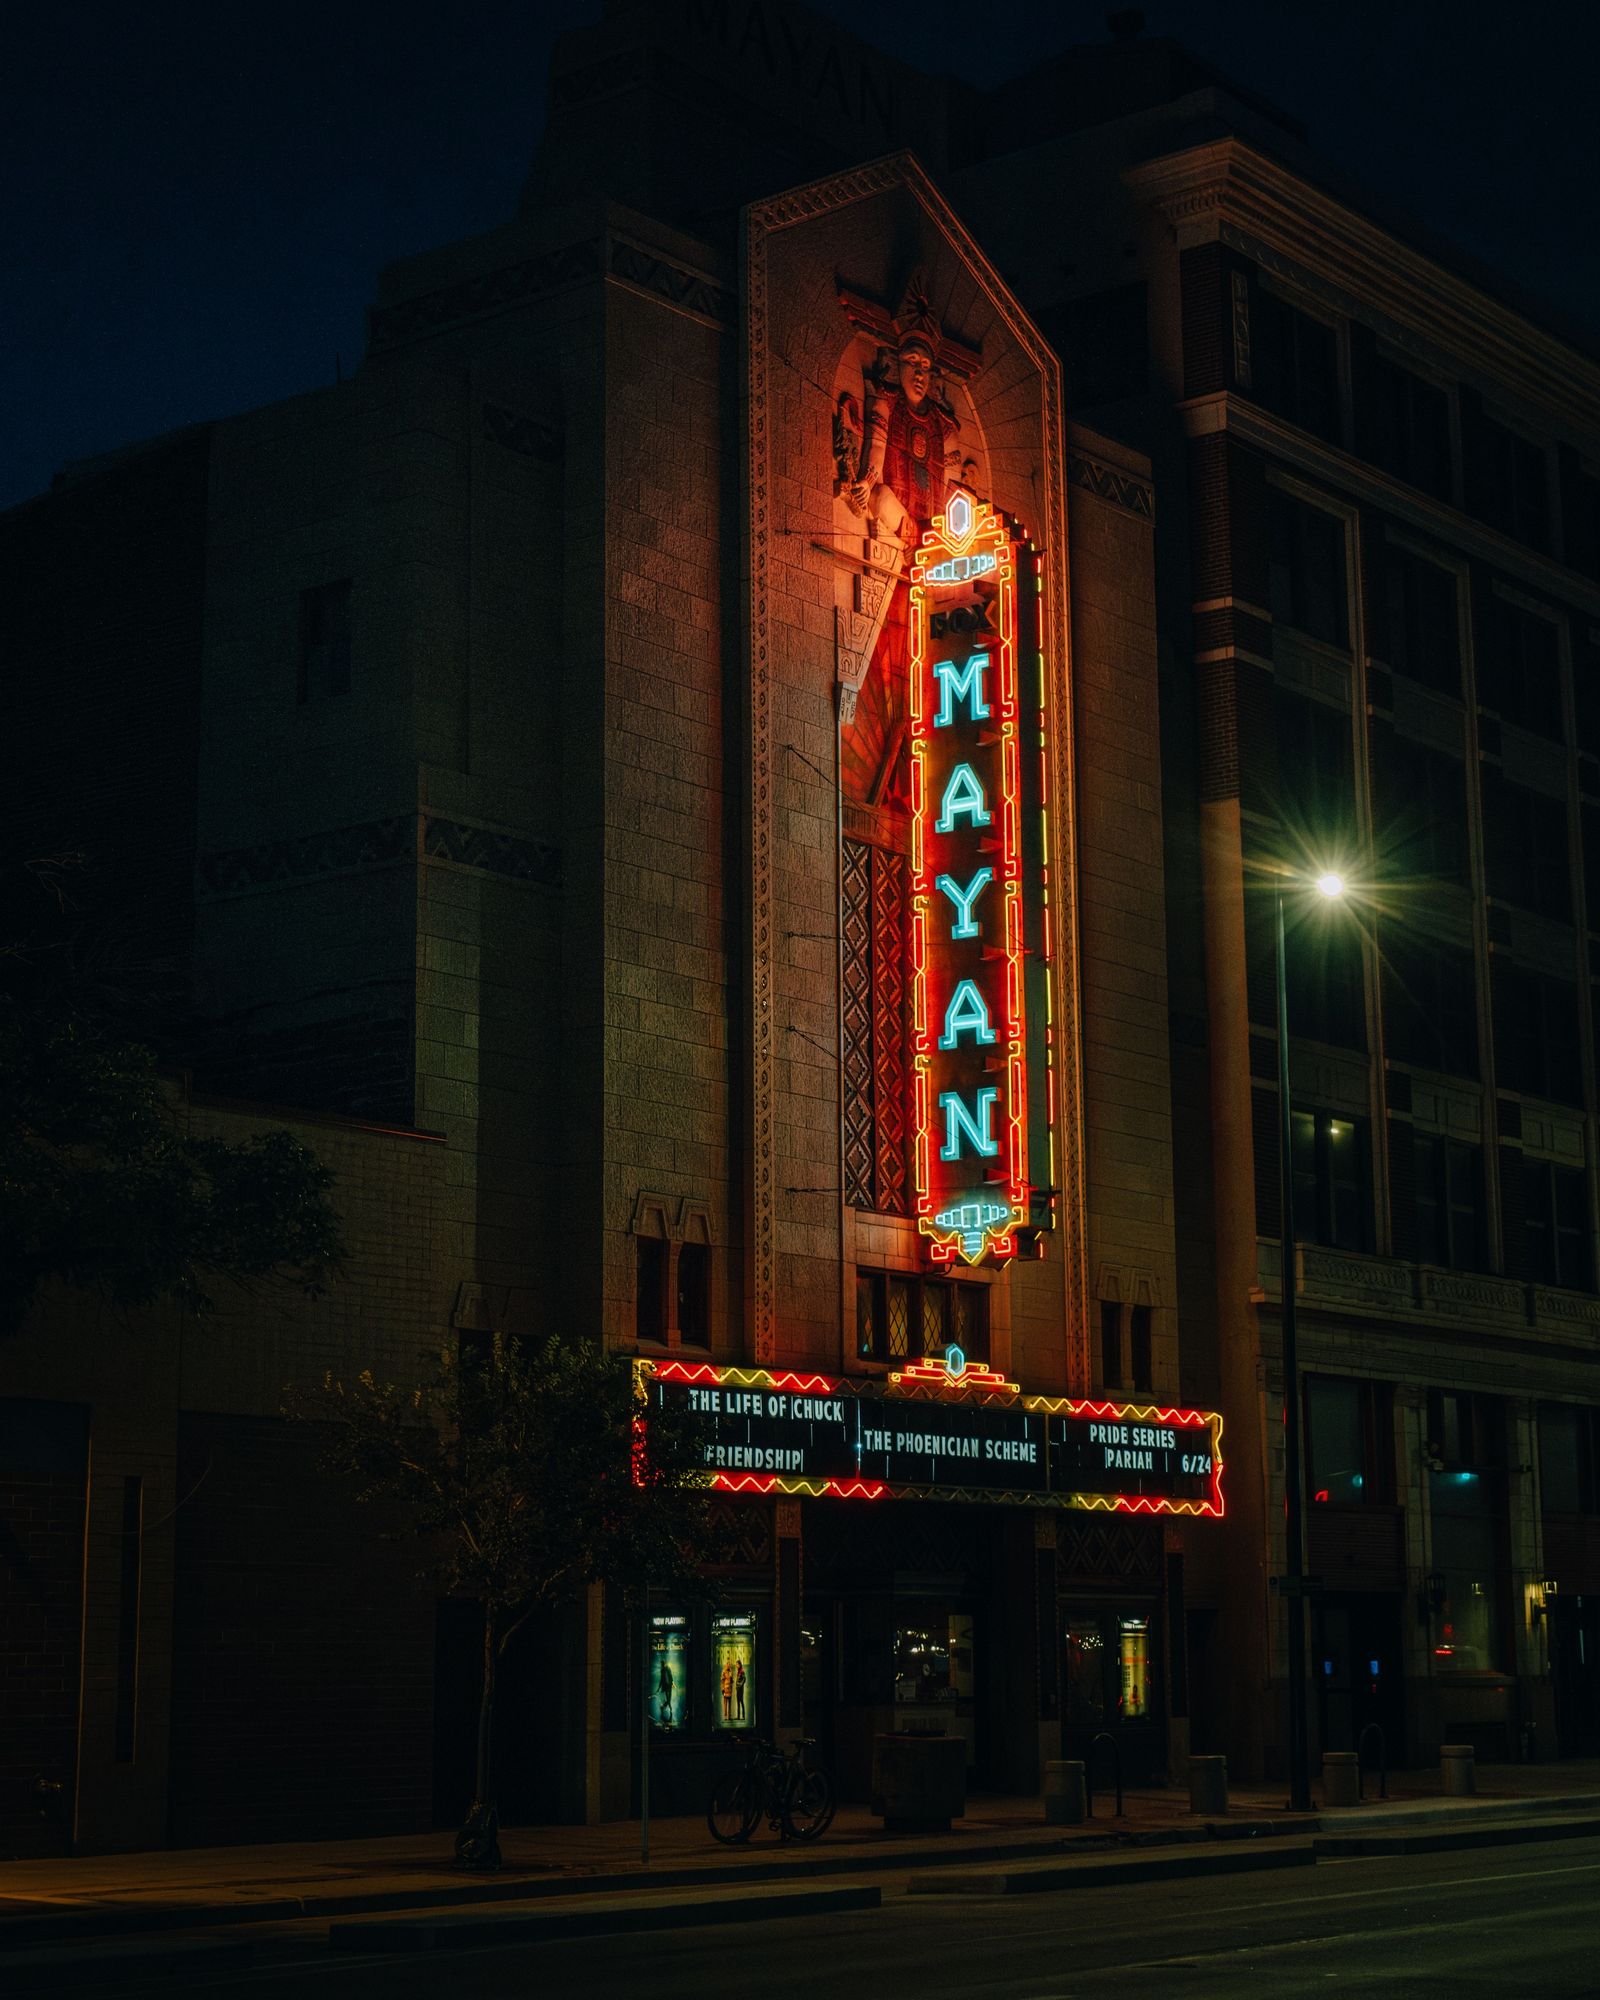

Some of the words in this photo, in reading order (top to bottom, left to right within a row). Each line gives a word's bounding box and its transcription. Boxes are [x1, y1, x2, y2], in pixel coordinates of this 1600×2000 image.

[933, 652, 999, 1162] MAYAN
[689, 1389, 720, 1412] THE
[726, 1392, 761, 1415] LIFE
[767, 1395, 787, 1417] OF
[793, 1398, 842, 1422] CHUCK
[864, 1430, 892, 1451] THE
[897, 1432, 979, 1458] PHOENICIAN
[985, 1440, 1037, 1463] SCHEME
[1090, 1424, 1128, 1445] PRIDE
[1132, 1427, 1175, 1449] SERIES
[705, 1444, 801, 1470] FRIENDSHIP
[1108, 1448, 1153, 1470] PARIAH
[1182, 1453, 1211, 1475] 6/24
